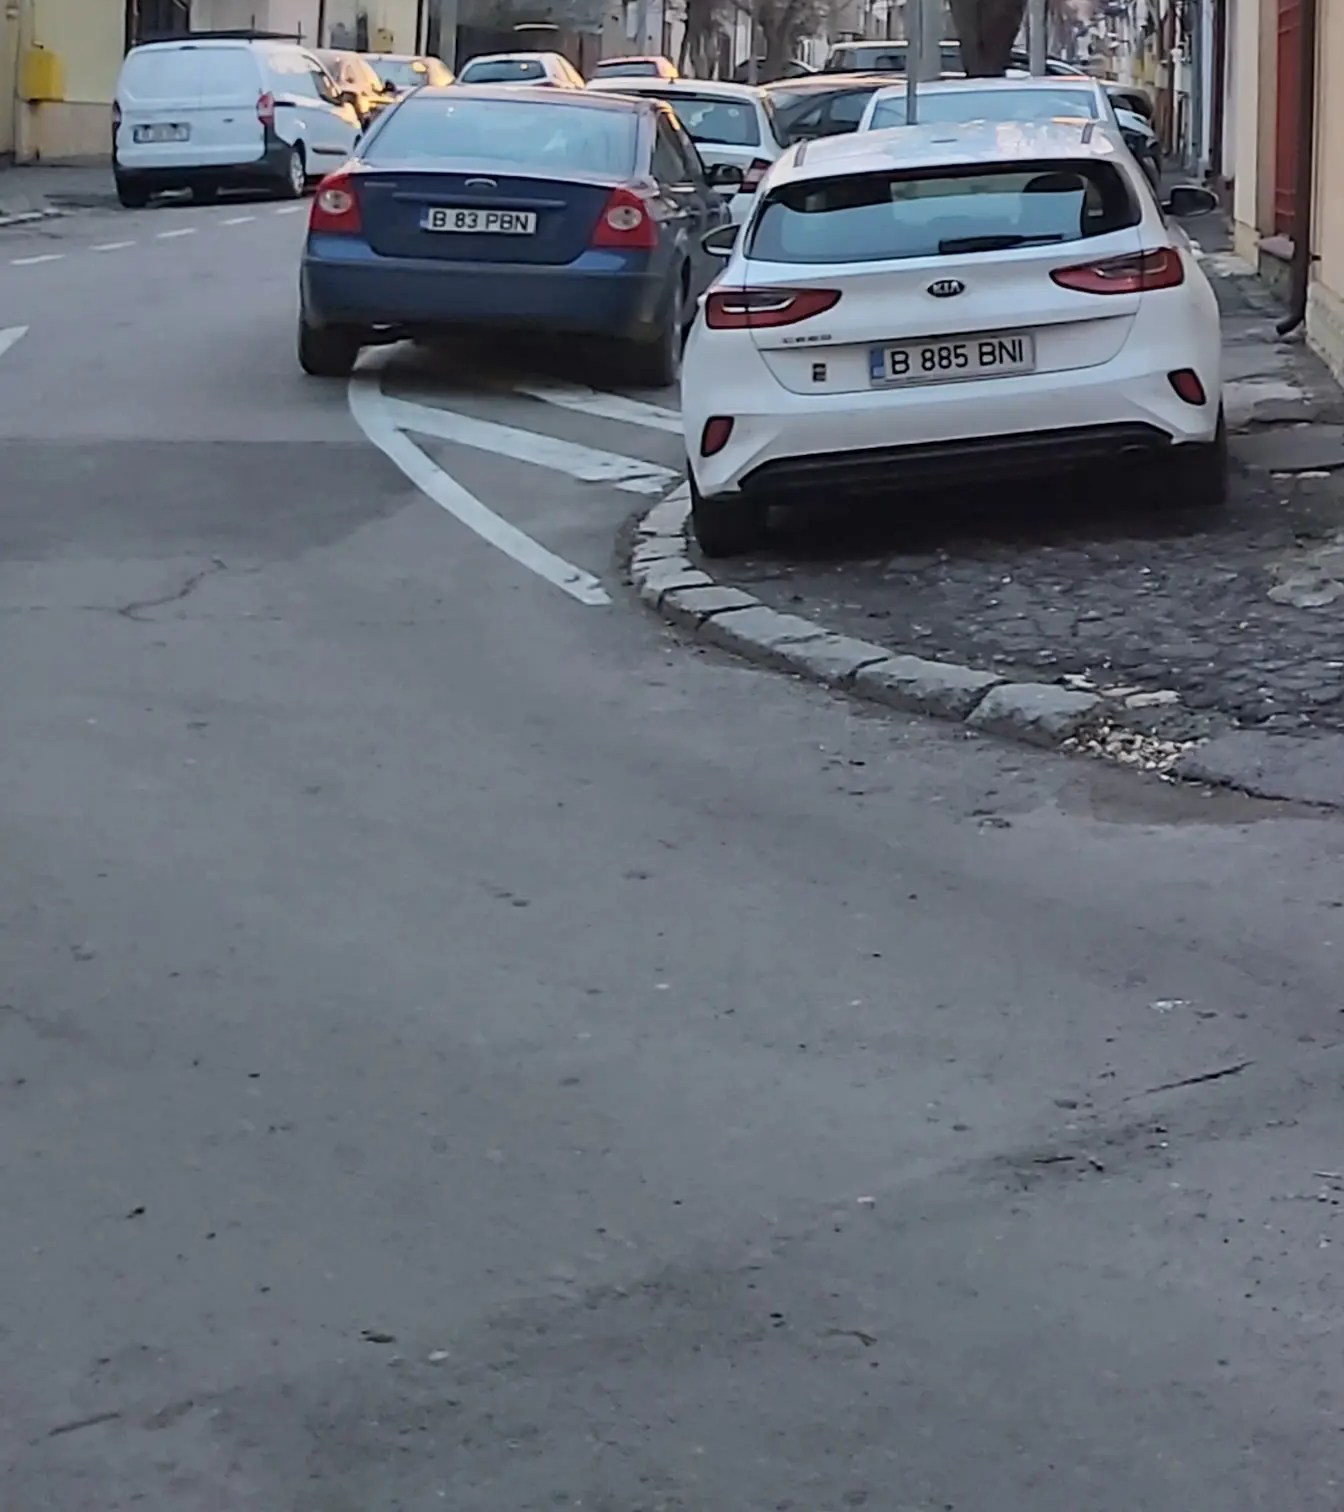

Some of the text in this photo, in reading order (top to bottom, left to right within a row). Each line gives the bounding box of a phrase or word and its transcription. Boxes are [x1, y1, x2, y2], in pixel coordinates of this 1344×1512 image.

[433, 211, 528, 231] B 83 PBN
[933, 281, 961, 293] KIA
[891, 339, 1024, 375] B 885 BNI
